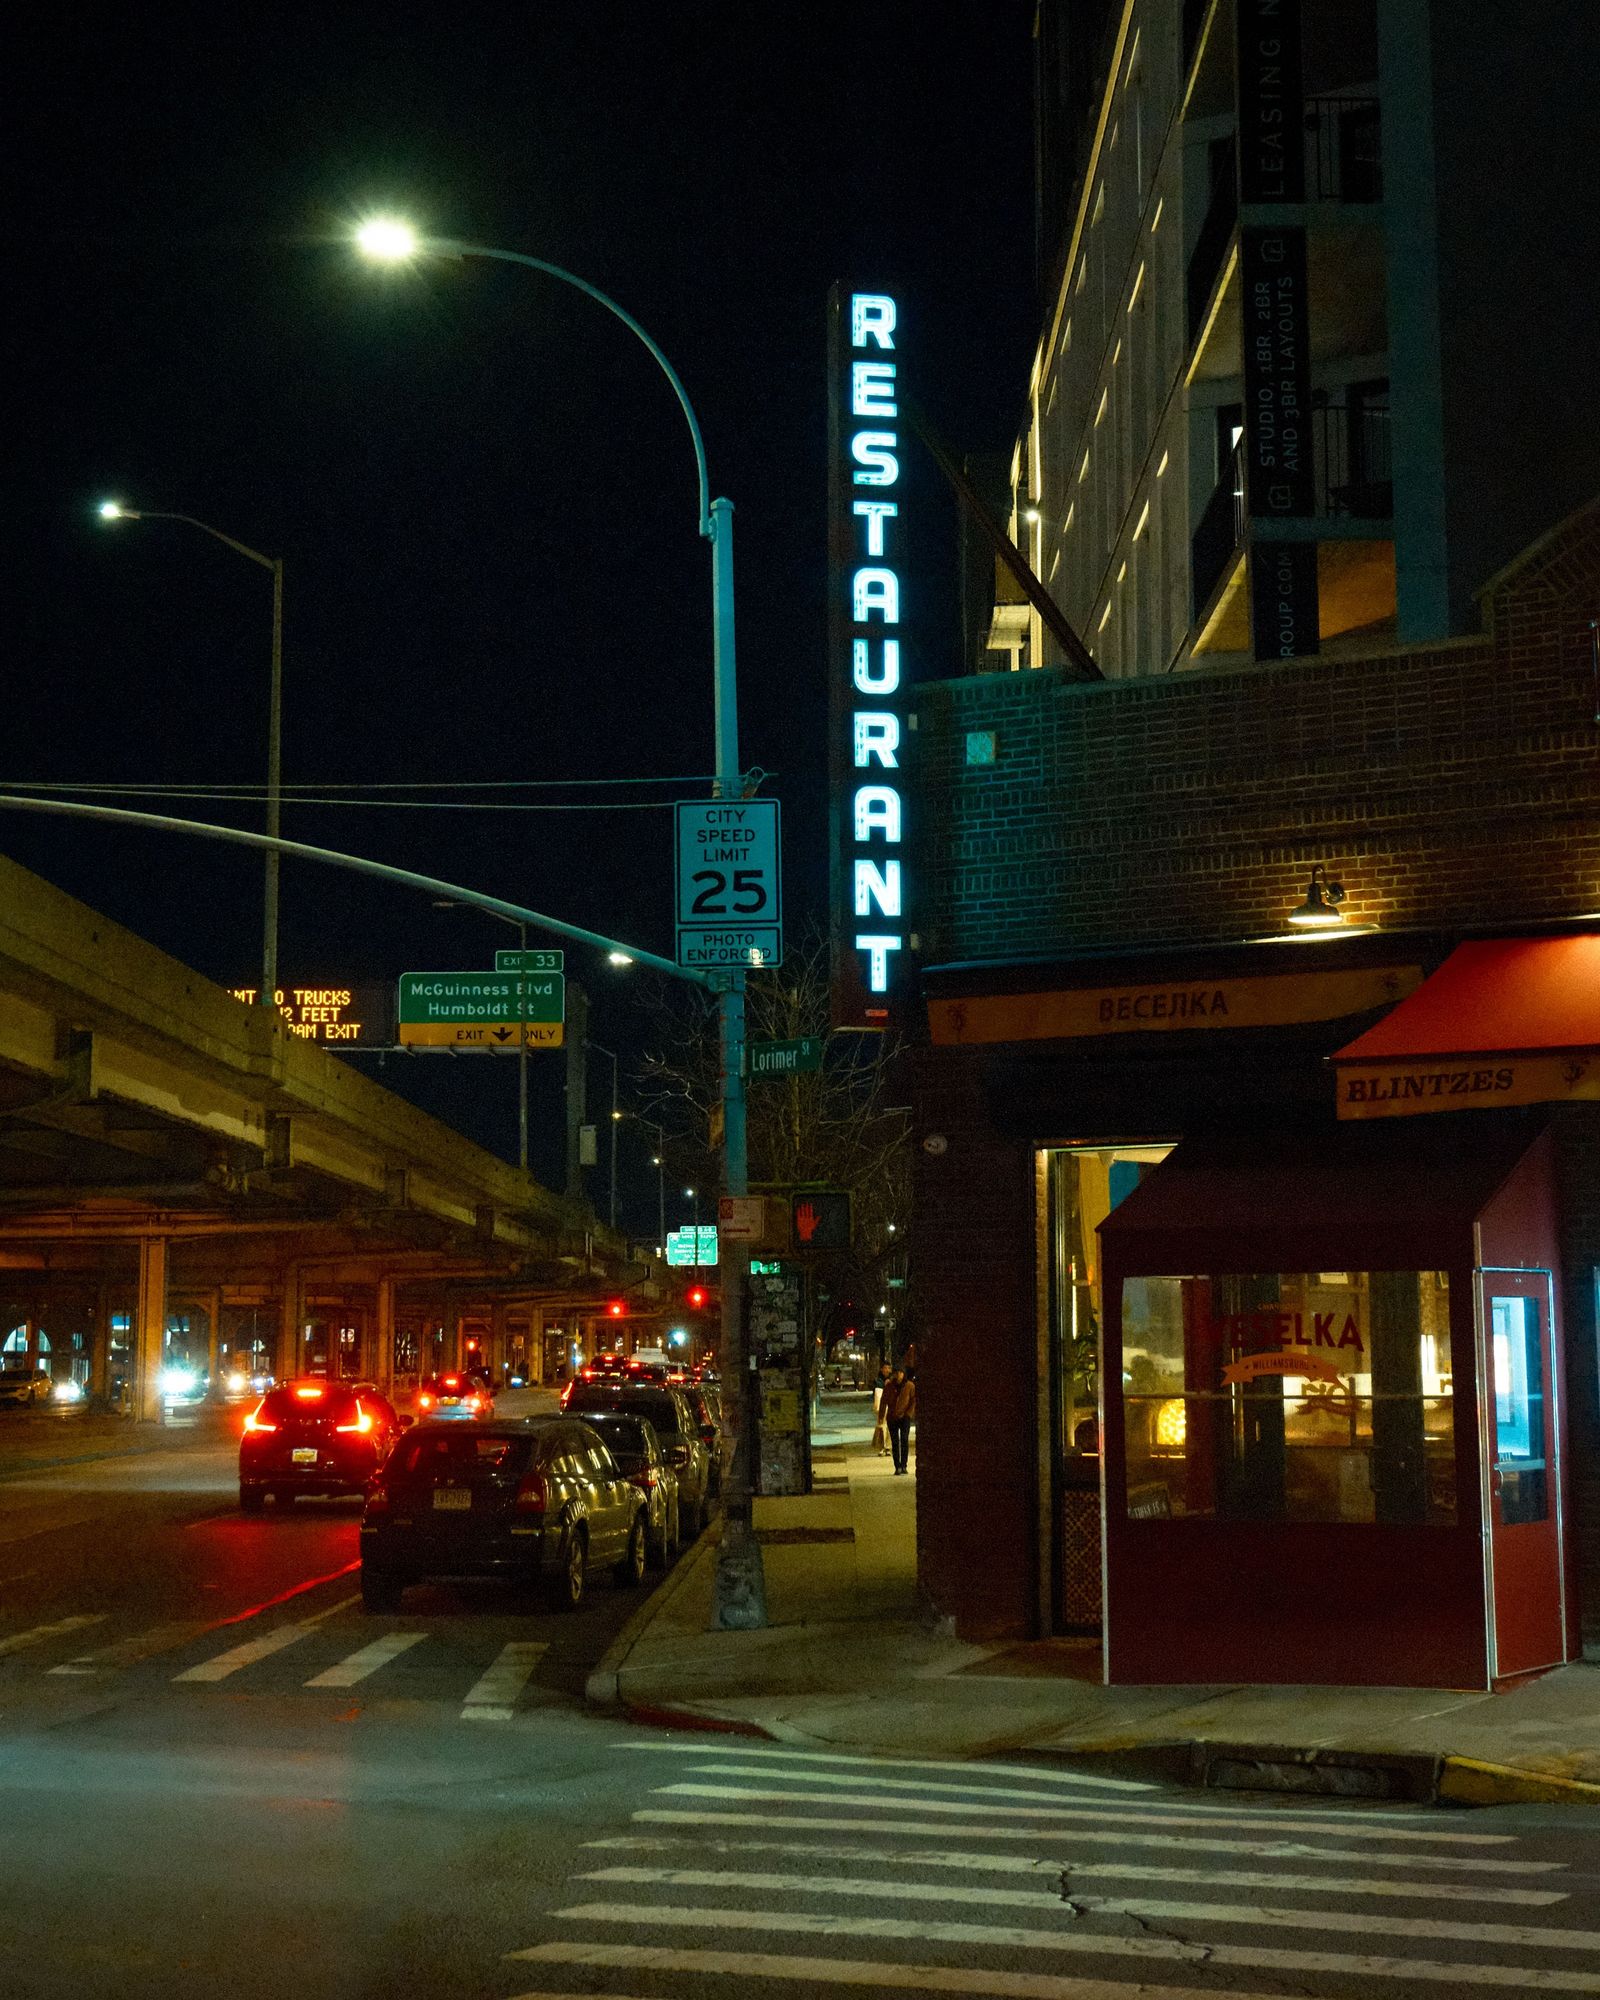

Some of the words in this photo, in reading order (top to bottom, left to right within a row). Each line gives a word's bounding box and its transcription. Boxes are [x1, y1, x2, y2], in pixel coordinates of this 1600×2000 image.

[1259, 38, 1285, 197] LEASING
[1254, 281, 1272, 321] 2BR
[1278, 275, 1297, 372] LAYOUTS
[1281, 381, 1300, 419] 3BR
[1282, 427, 1299, 472] AND
[851, 293, 902, 993] RESTAURANT
[705, 809, 746, 825] CITY
[696, 828, 756, 844] SPEED
[703, 847, 750, 863] LIMIT
[691, 869, 767, 915] 25
[703, 934, 755, 947] PHOTO
[536, 955, 556, 967] 33
[293, 989, 352, 1006] TRUCKS
[411, 983, 509, 996] McGuinness
[301, 1006, 342, 1023] FEET
[428, 1002, 509, 1016] Humboldt
[1099, 990, 1230, 1022] ВЕСЕЛКА
[325, 1023, 362, 1040] EXIT
[456, 1030, 485, 1041] EXIT
[751, 1047, 798, 1072] Lorimer
[1345, 1067, 1516, 1103] BLINTZES
